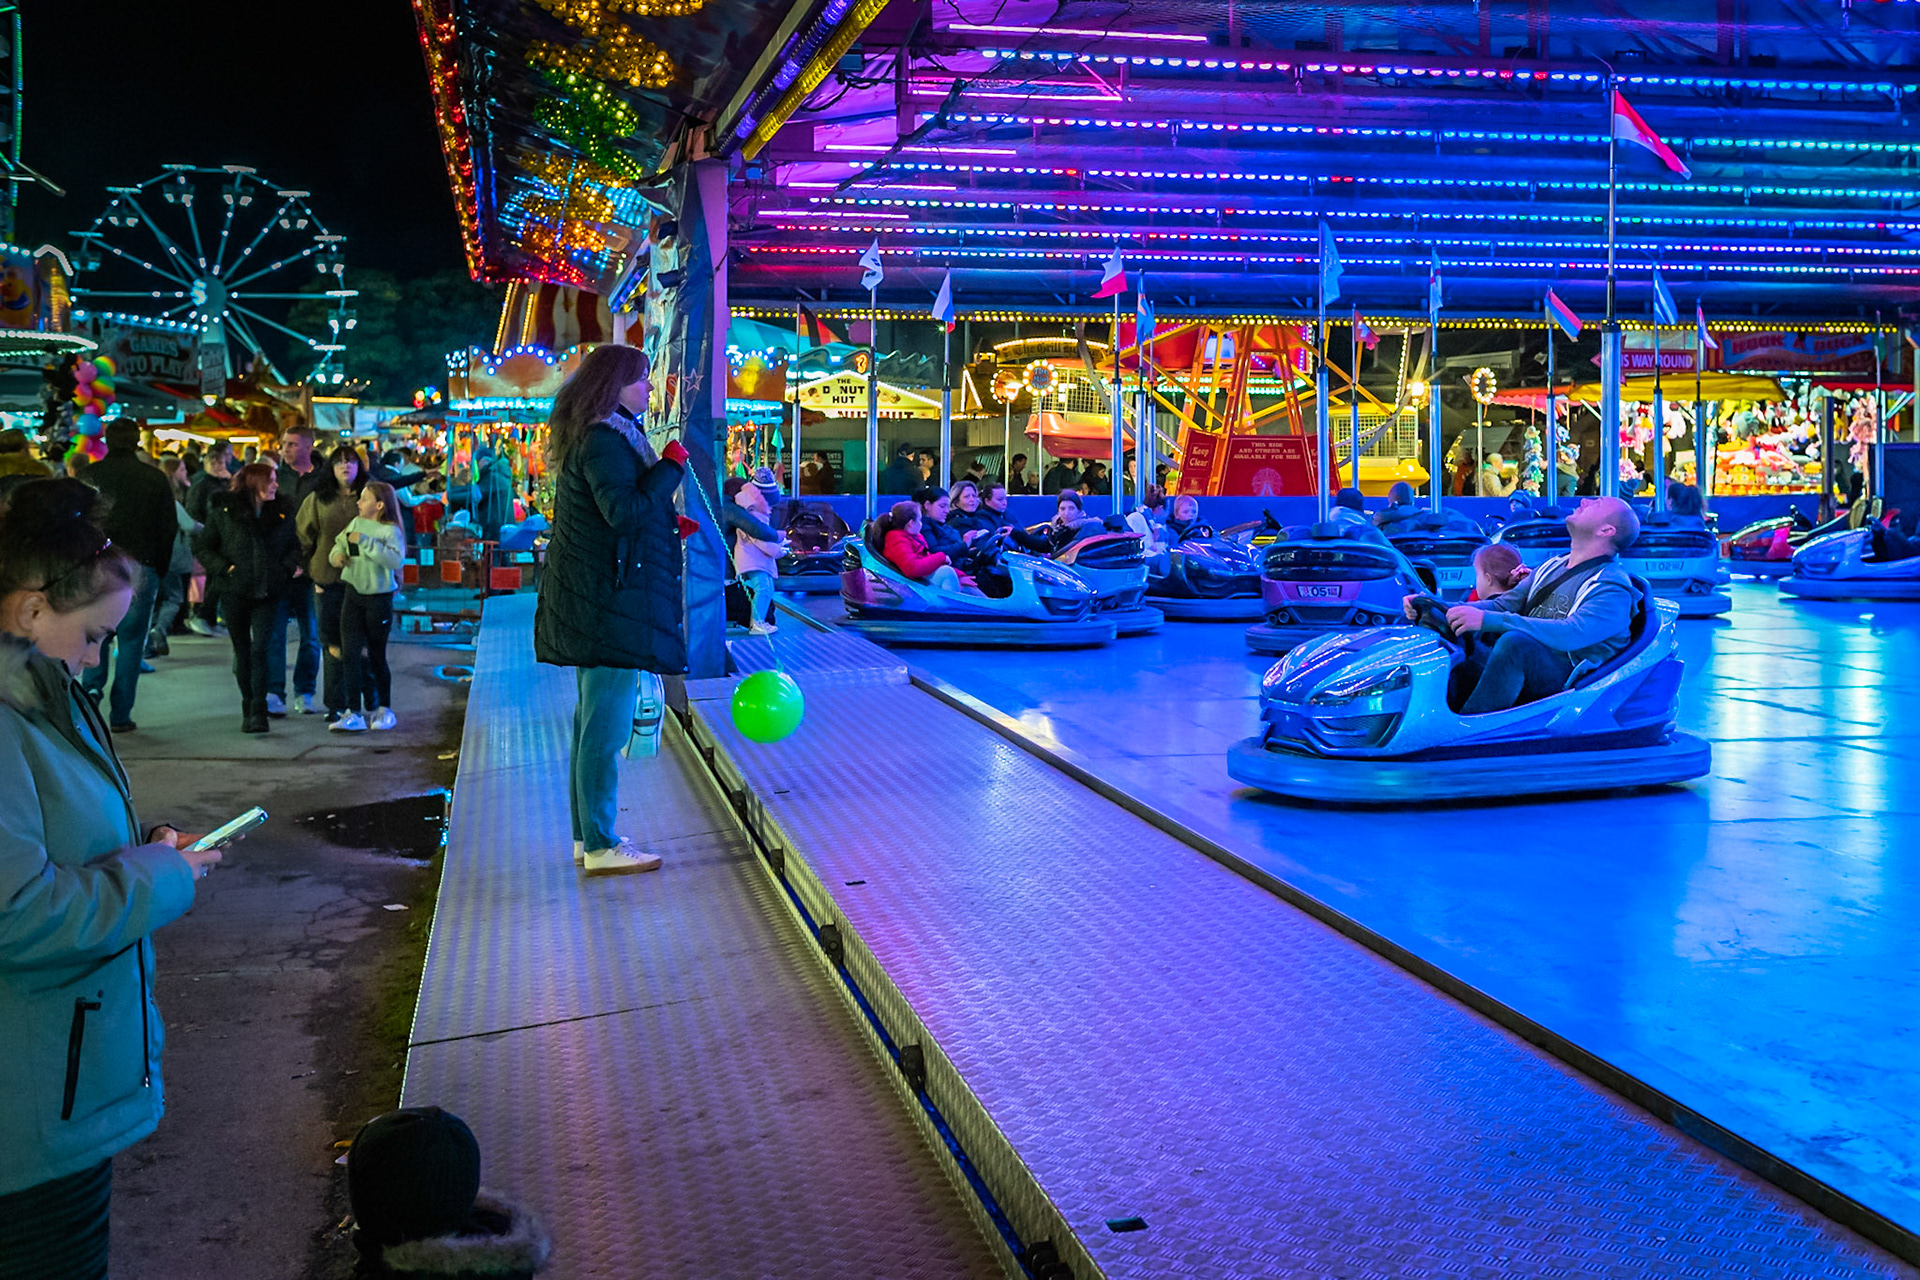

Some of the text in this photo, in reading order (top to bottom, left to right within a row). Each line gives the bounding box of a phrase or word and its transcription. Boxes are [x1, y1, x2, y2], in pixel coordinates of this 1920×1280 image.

[131, 336, 178, 357] GAMES
[1036, 341, 1061, 353] Grill
[1631, 354, 1654, 367] WAY
[1658, 354, 1693, 367] ROUND
[128, 356, 147, 373] TO
[150, 356, 184, 377] PLAY
[823, 386, 865, 394] DNUT
[832, 396, 855, 404] HUT
[1192, 446, 1209, 457] Keep
[1189, 458, 1208, 467] Clear
[1658, 562, 1673, 571] 02
